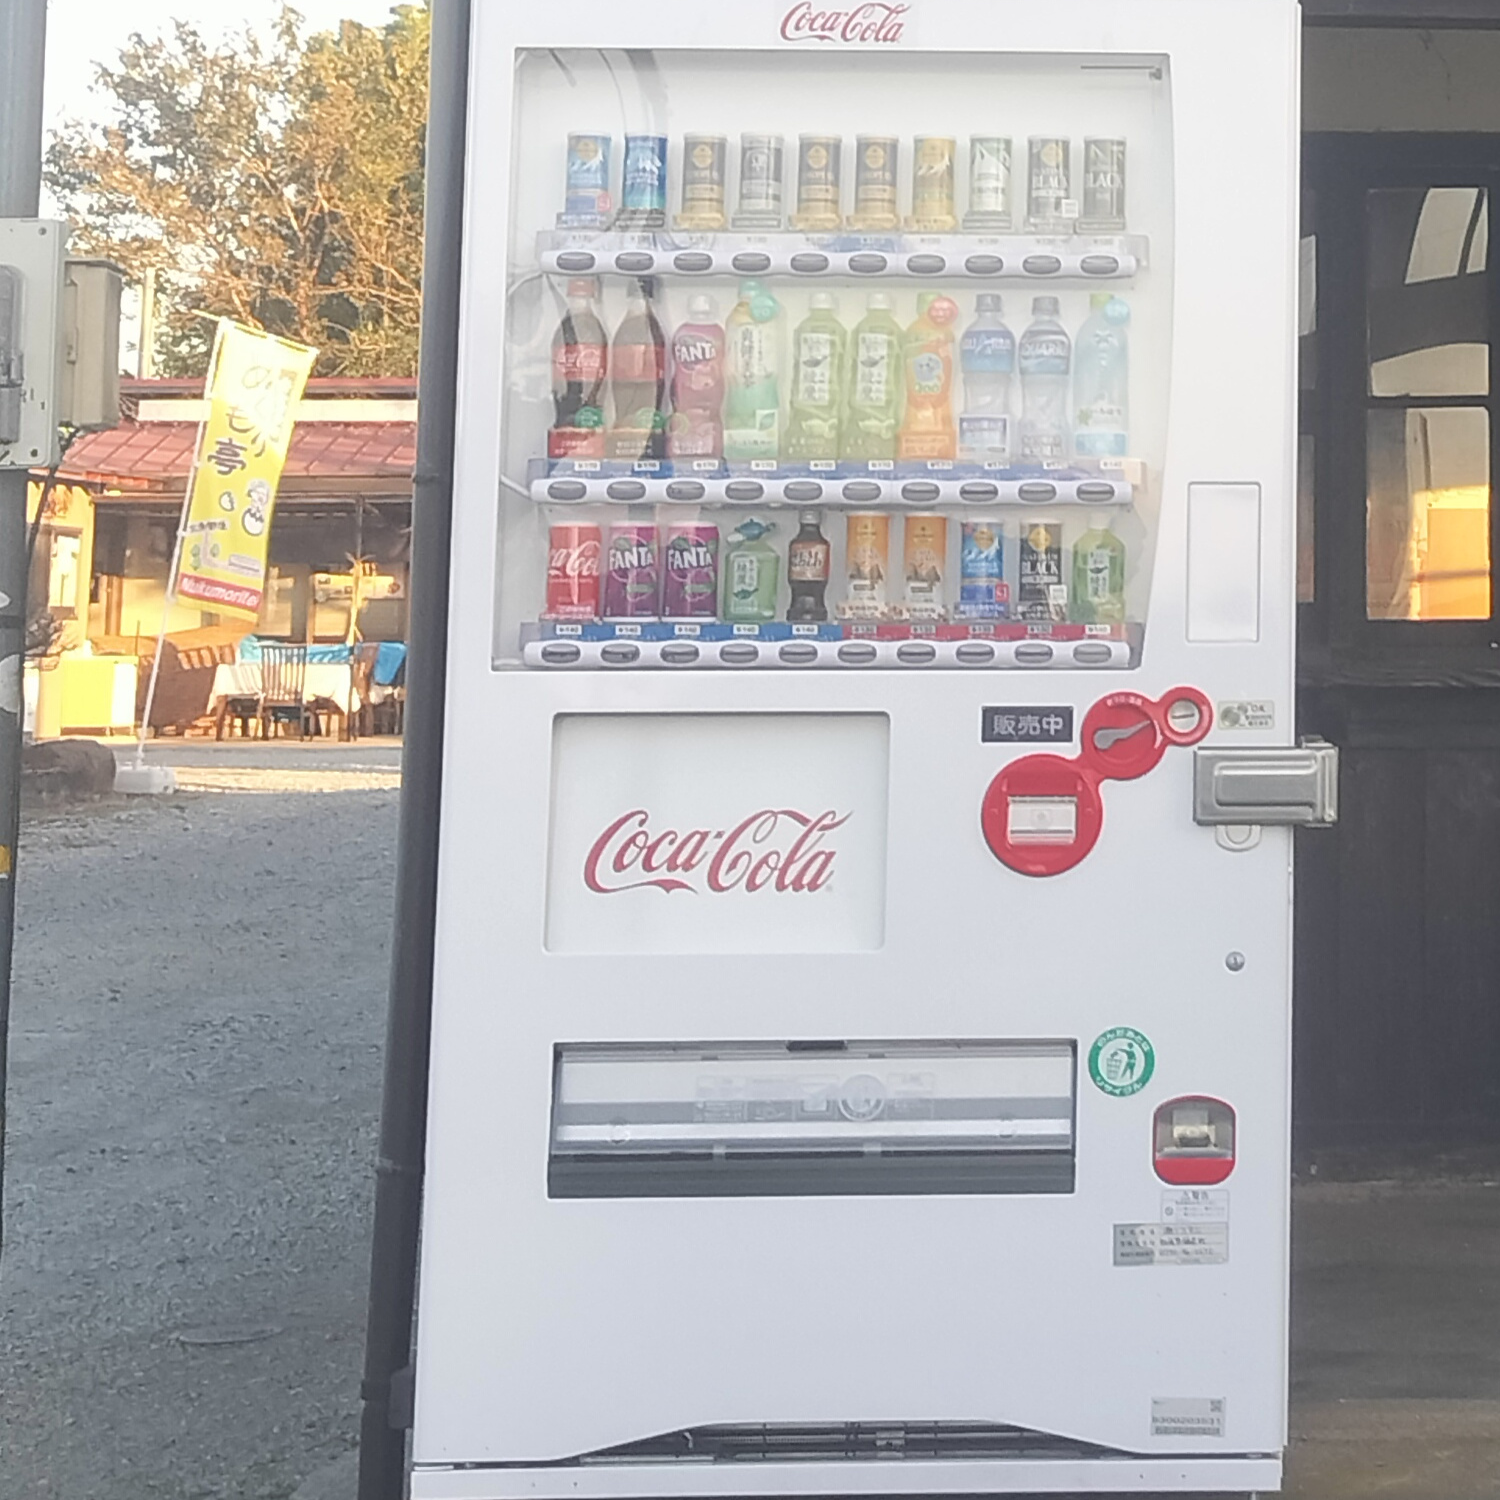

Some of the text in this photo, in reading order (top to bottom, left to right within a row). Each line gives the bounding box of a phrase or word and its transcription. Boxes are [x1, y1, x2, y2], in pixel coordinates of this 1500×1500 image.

[780, 1, 911, 42] Coca-Cola
[609, 547, 653, 571] FANTA
[668, 547, 712, 571] FANTA
[992, 713, 1064, 737] 販売中
[584, 810, 853, 895] Coca-Cola
